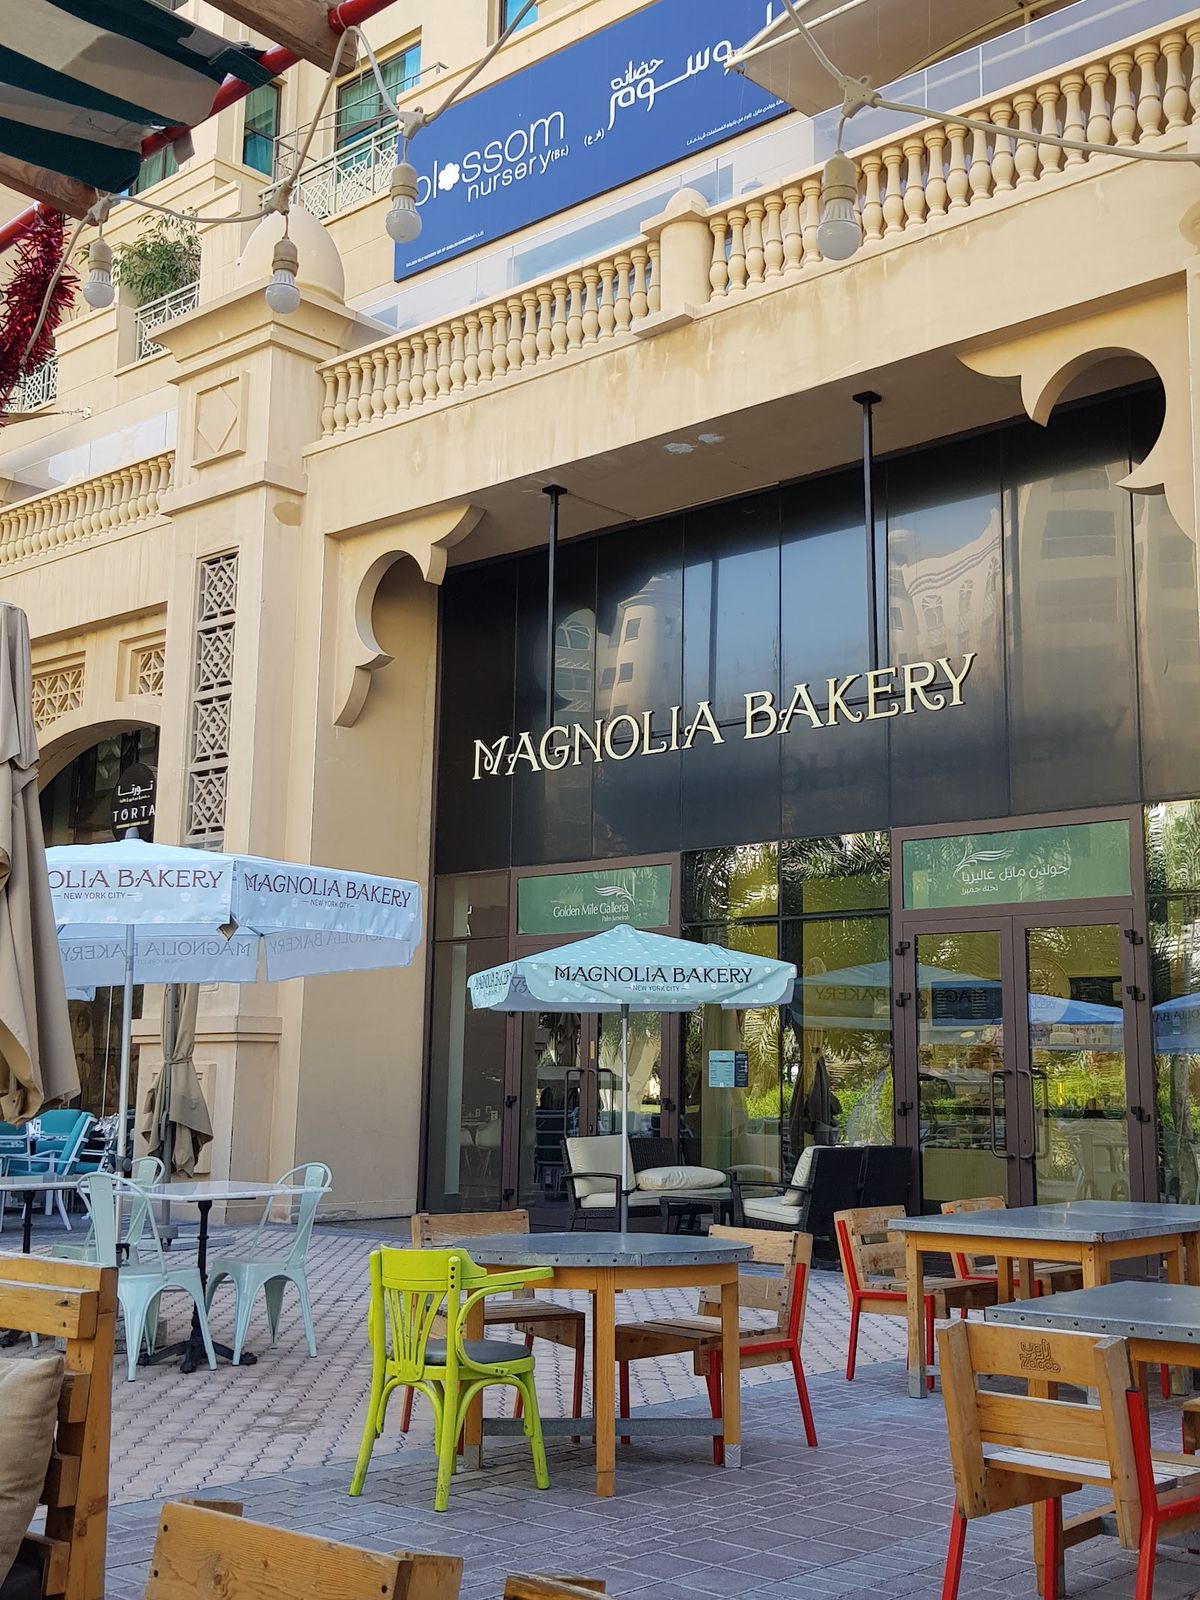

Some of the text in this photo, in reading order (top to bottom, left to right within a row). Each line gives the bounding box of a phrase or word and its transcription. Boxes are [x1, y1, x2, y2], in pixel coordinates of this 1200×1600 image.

[472, 652, 977, 780] MAGNOLIA BAKERY
[112, 804, 156, 823] TORTA
[48, 870, 110, 889] OLIA
[117, 869, 224, 889] BAKERY
[63, 891, 126, 900] NEW YORK CITY
[244, 873, 412, 908] MAGNOLIA BAKERY
[553, 901, 629, 918] Golden Mile Galleria
[554, 965, 753, 983] MAGNOLIA BAKERY
[648, 984, 666, 992] YORK
[666, 984, 680, 992] CITY
